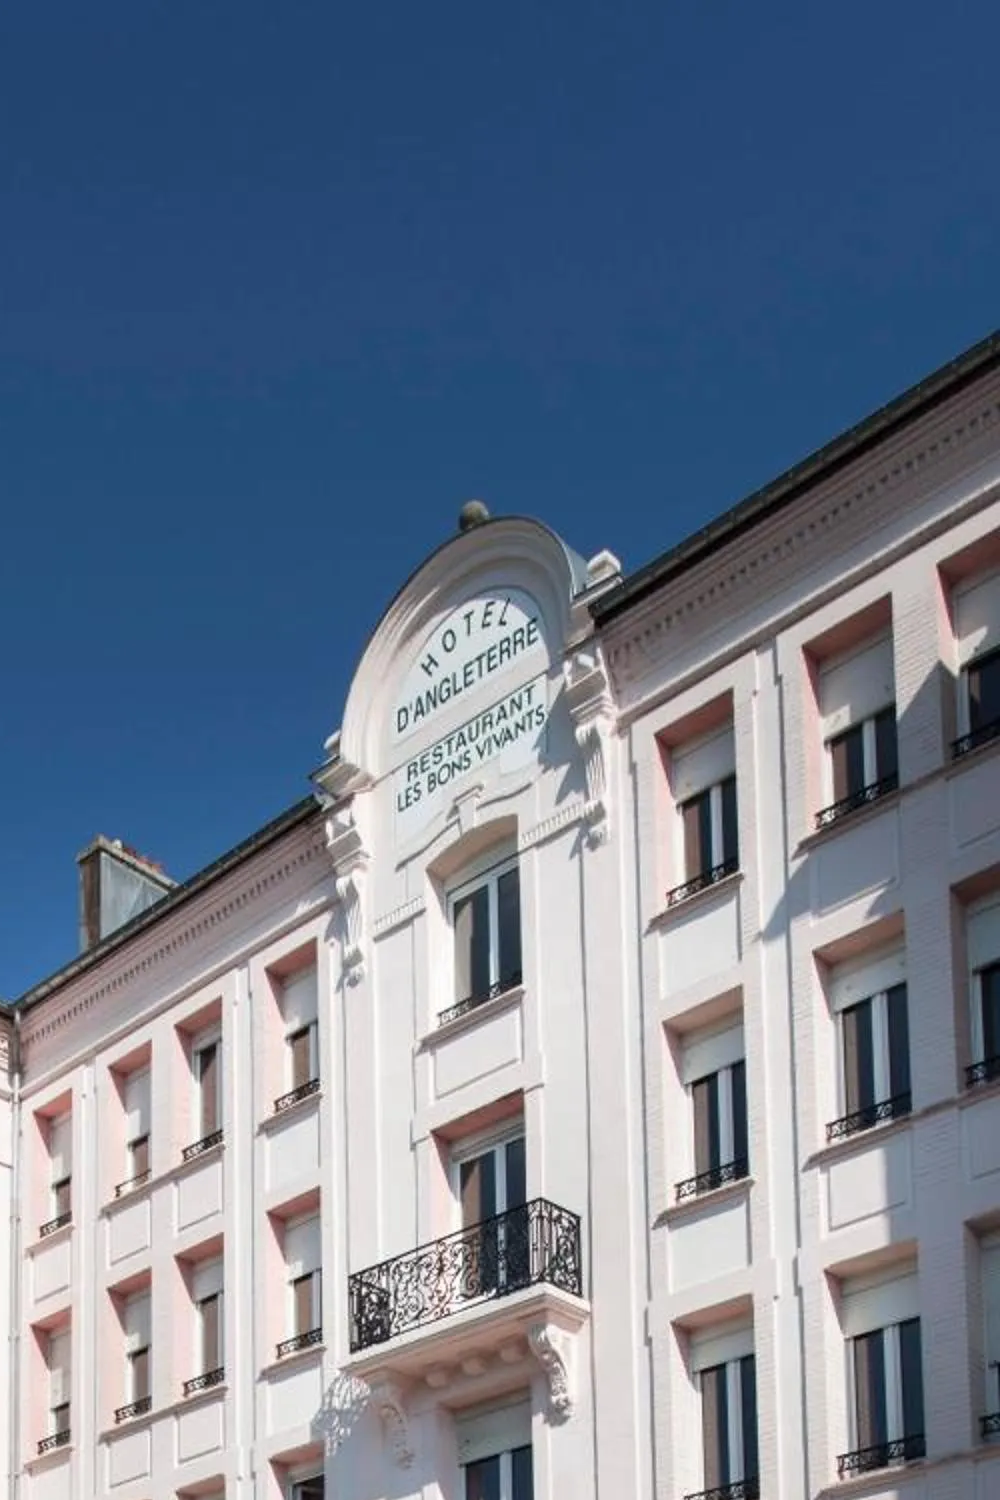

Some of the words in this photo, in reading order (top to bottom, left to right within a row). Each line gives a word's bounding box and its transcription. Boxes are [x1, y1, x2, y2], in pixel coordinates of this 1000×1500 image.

[397, 618, 540, 734] D'ANGLETERRE
[421, 597, 511, 677] HOTEL
[397, 784, 422, 813] LES
[427, 749, 472, 795] BONS
[475, 704, 546, 761] VIVANTS
[407, 684, 536, 783] RESTAURANT
